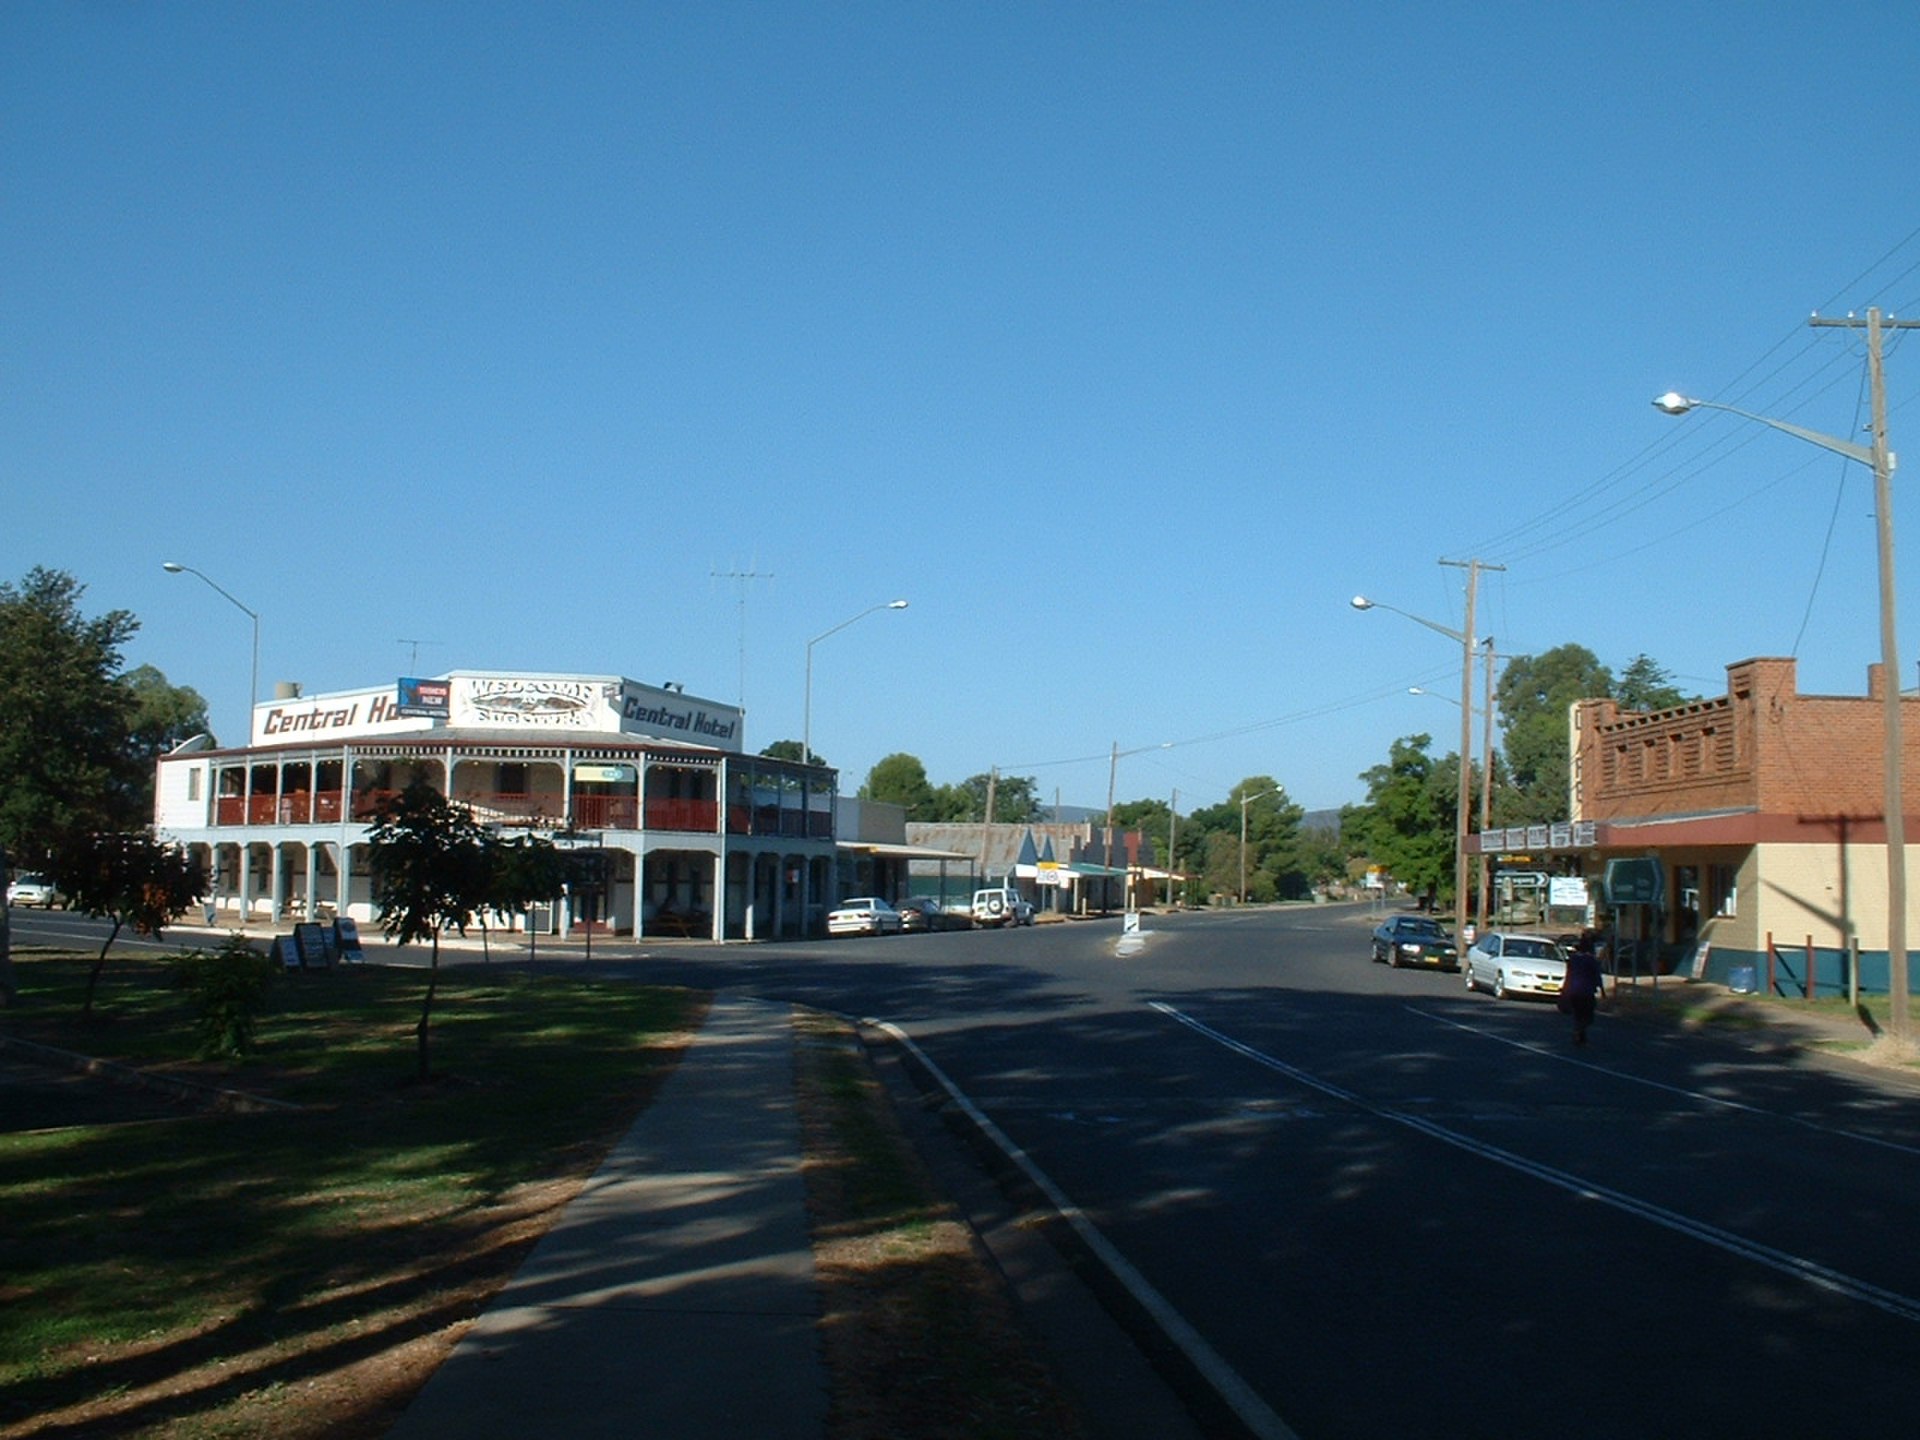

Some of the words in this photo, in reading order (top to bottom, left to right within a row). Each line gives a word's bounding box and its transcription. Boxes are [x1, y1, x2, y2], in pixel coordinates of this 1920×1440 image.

[472, 681, 593, 698] WELCOME
[264, 704, 359, 735] Central
[623, 696, 692, 730] Central
[694, 711, 735, 739] Hotel
